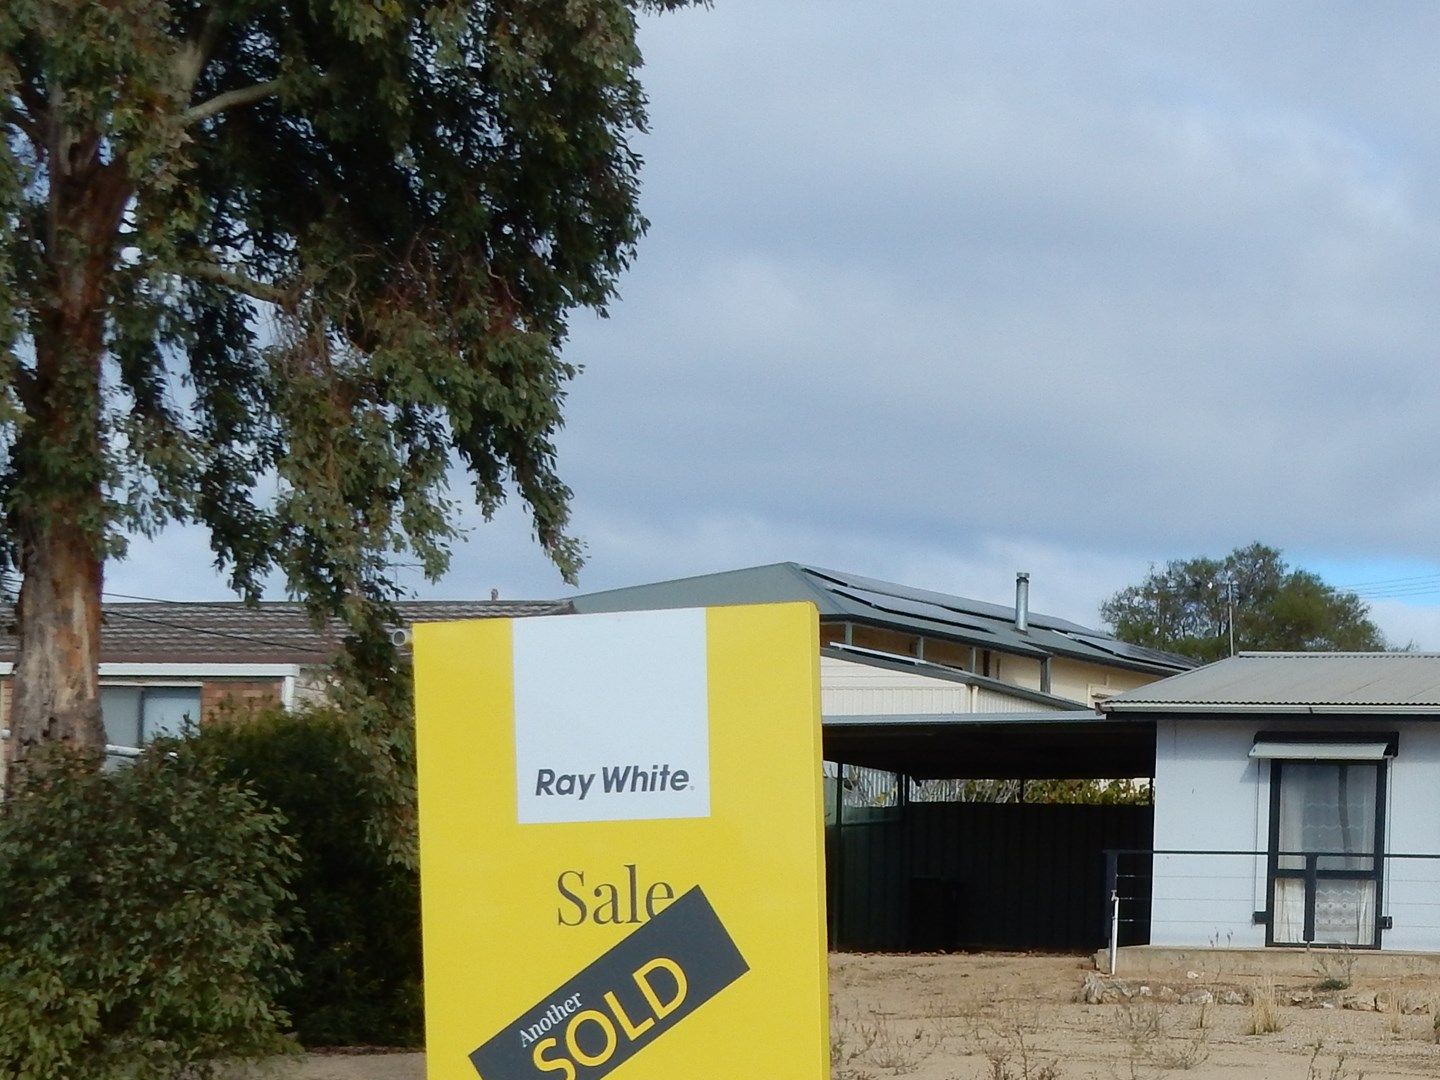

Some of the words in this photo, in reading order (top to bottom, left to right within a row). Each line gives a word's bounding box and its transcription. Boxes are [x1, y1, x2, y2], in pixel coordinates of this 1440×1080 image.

[535, 768, 596, 800] Ray
[602, 764, 690, 794] White
[557, 864, 675, 926] Sale
[518, 992, 582, 1048] Another
